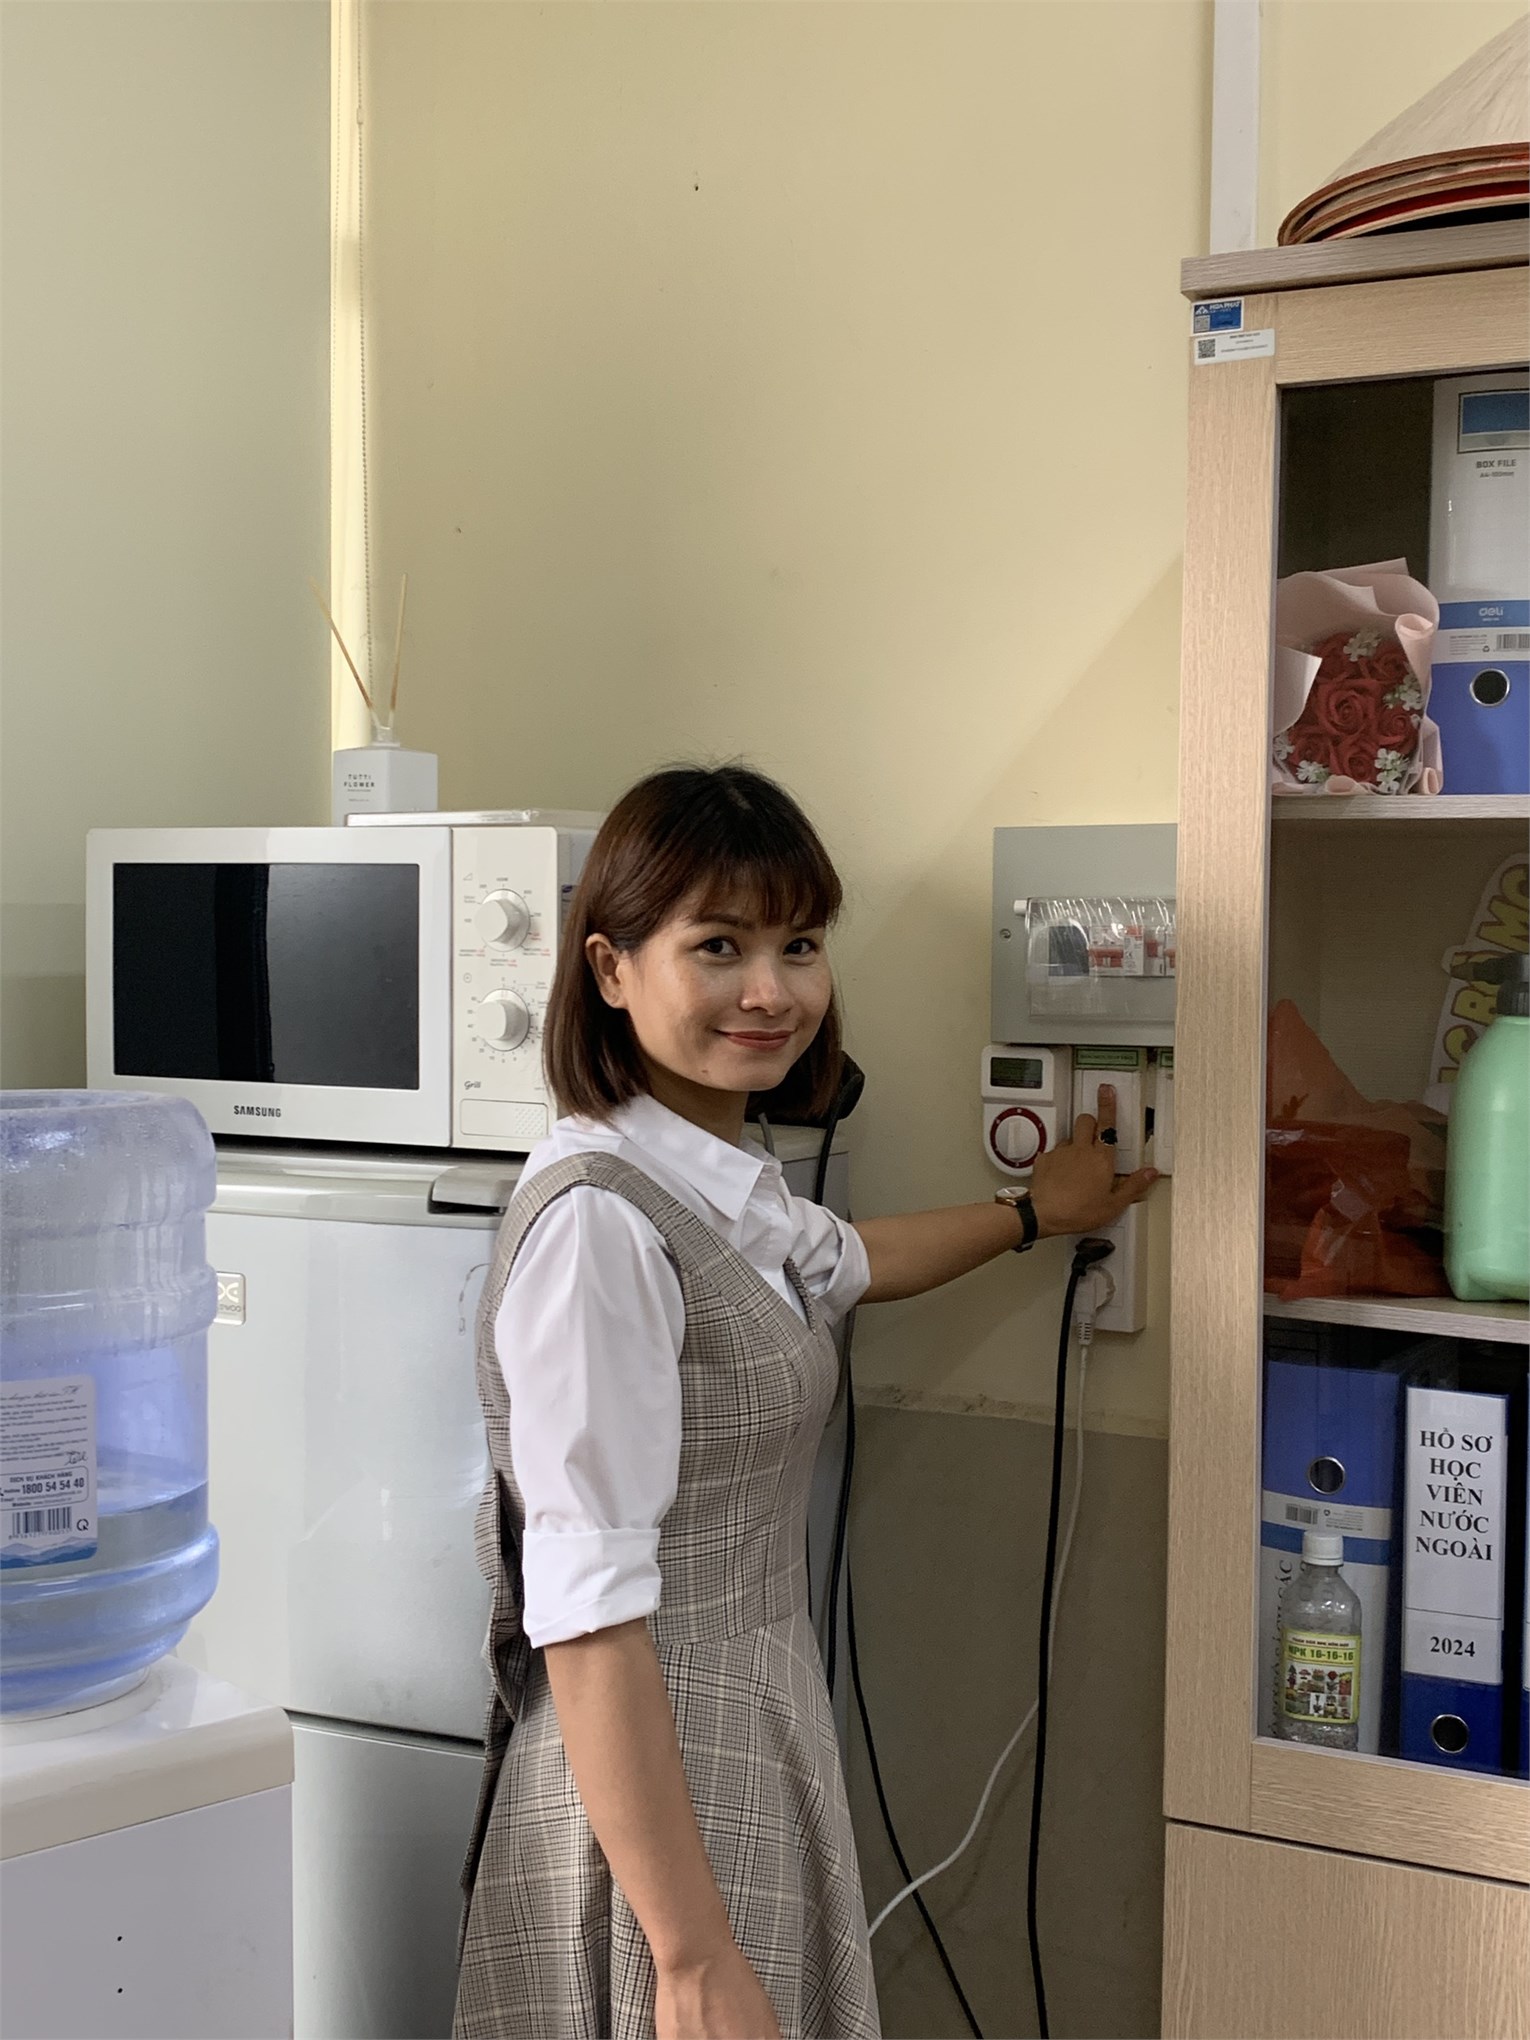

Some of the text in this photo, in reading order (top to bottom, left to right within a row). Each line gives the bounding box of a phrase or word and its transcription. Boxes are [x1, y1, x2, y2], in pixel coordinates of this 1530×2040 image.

[1498, 459, 1517, 467] FILE
[1479, 607, 1504, 616] deli
[464, 1081, 481, 1090] Grill
[233, 1105, 281, 1118] SAMSUNG
[1419, 1427, 1493, 1453] HỒ SƠ
[1429, 1457, 1481, 1481] HỌC
[22, 1482, 43, 1494] 1800
[45, 1481, 57, 1492] 54
[60, 1479, 71, 1490] 54
[73, 1477, 85, 1488] 40
[1426, 1482, 1483, 1506] VIÊN
[1419, 1509, 1489, 1534] NƯỚC
[1415, 1536, 1494, 1561] NGOÀI
[1288, 1644, 1354, 1661] NPK 16-16-16
[1430, 1636, 1476, 1657] 2024
